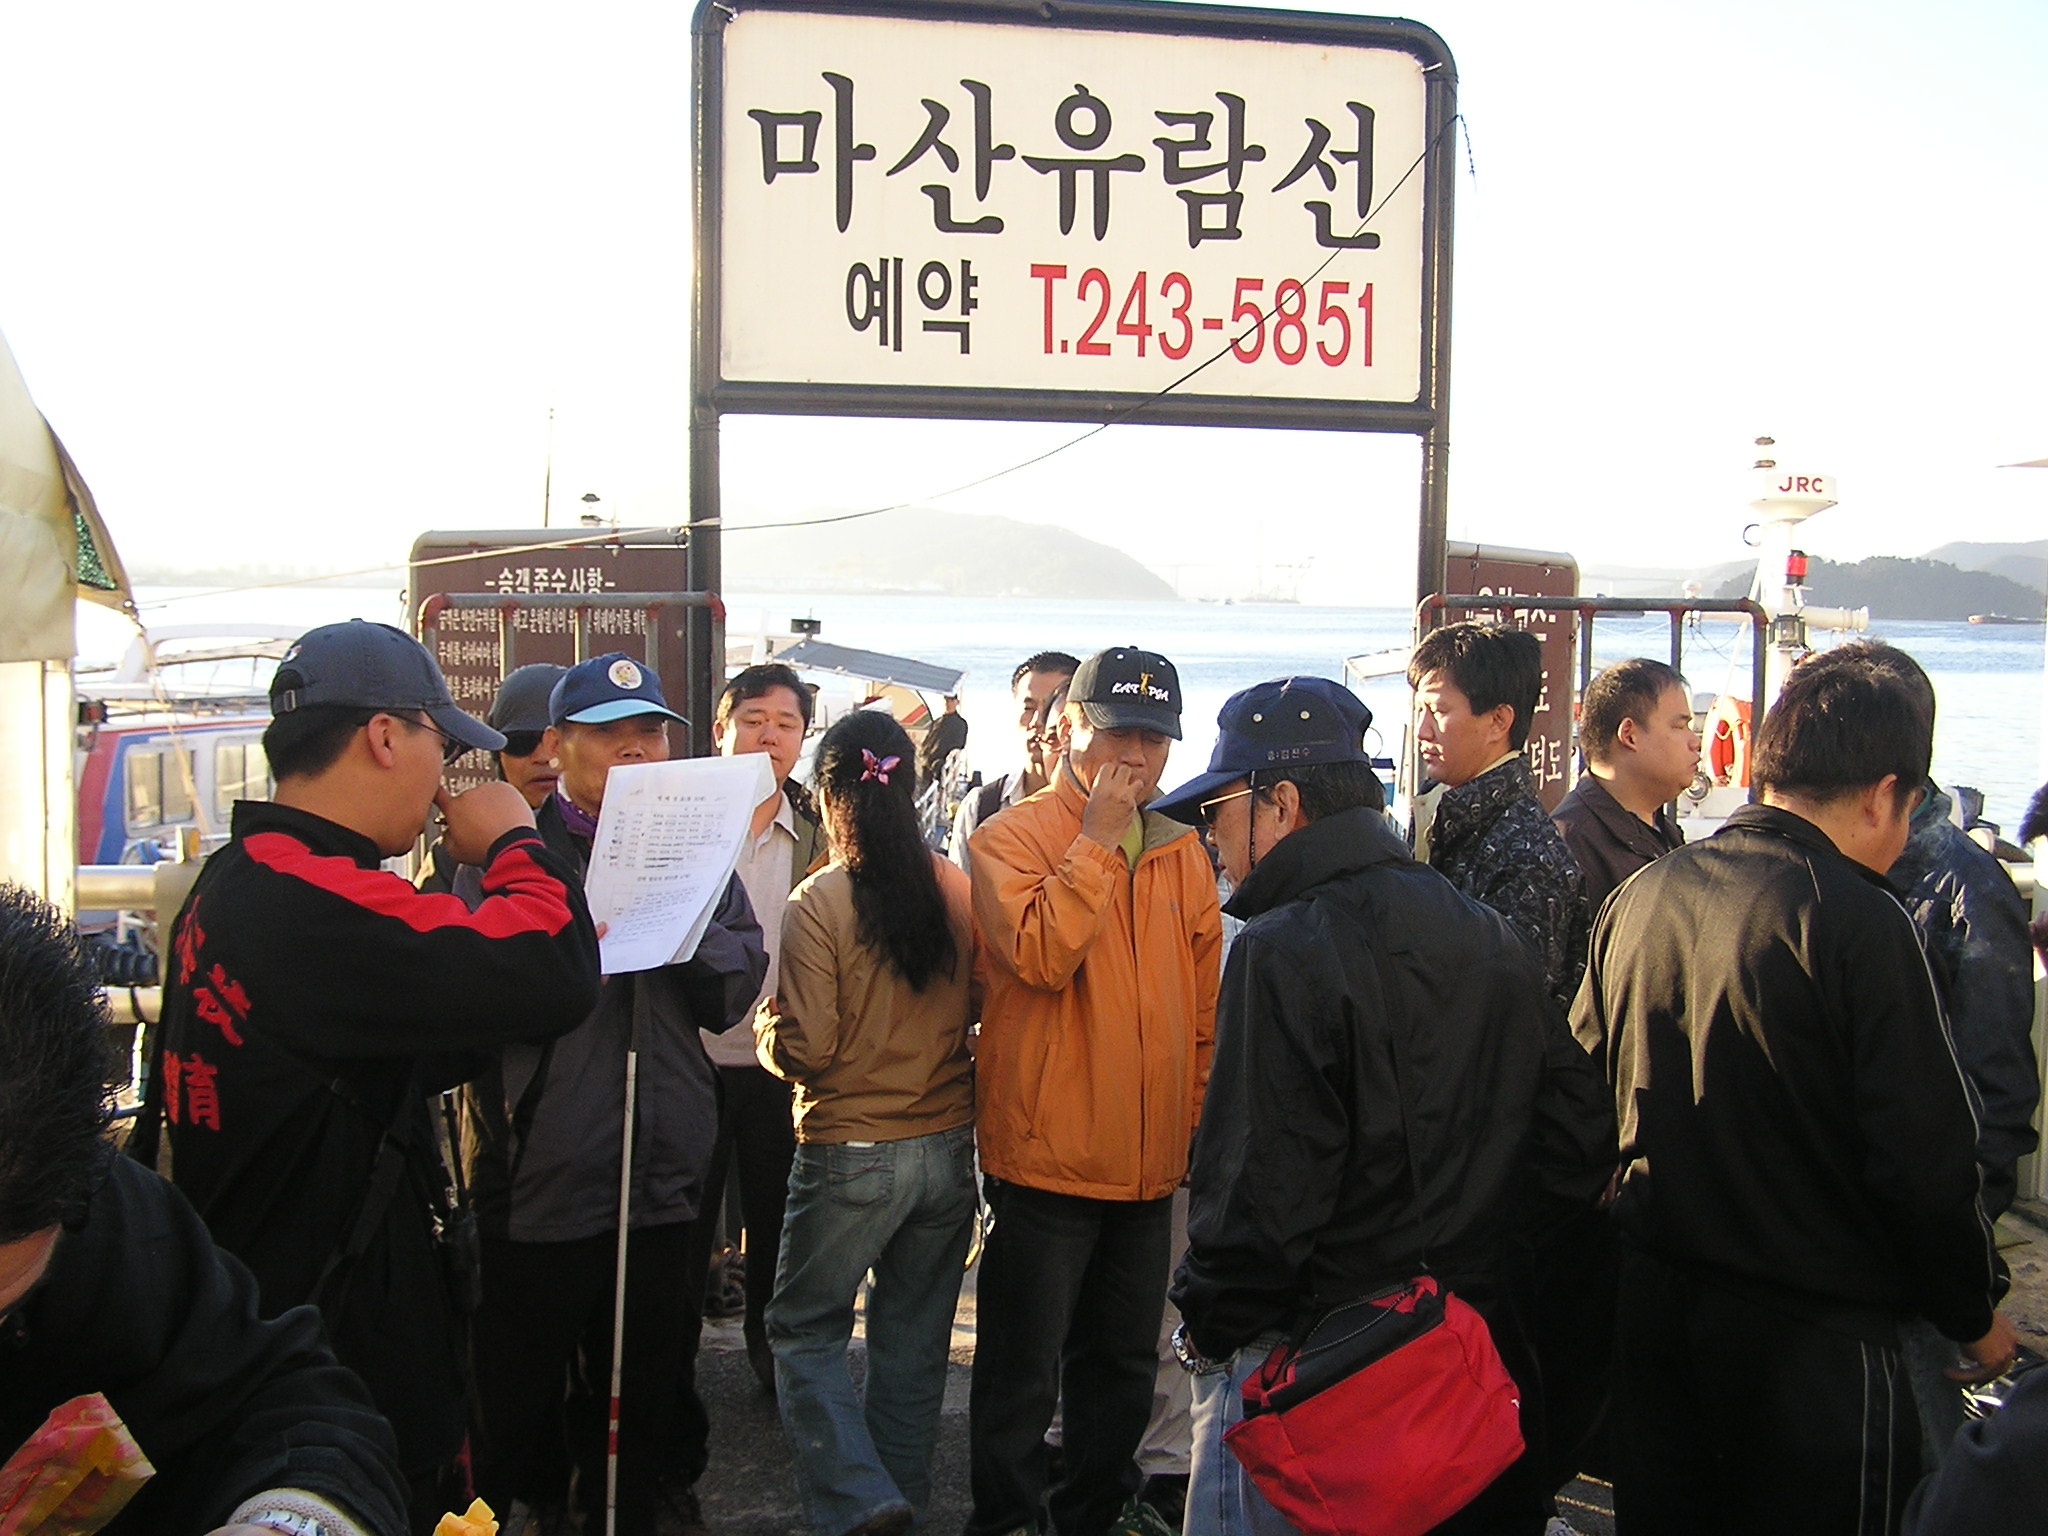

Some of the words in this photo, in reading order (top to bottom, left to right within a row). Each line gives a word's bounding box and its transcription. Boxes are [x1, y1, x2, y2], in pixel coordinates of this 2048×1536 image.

[747, 71, 1381, 249] 마산유람선
[845, 257, 980, 355] 예약
[1030, 263, 1374, 368] T.243-5851
[1778, 476, 1823, 493] JRC
